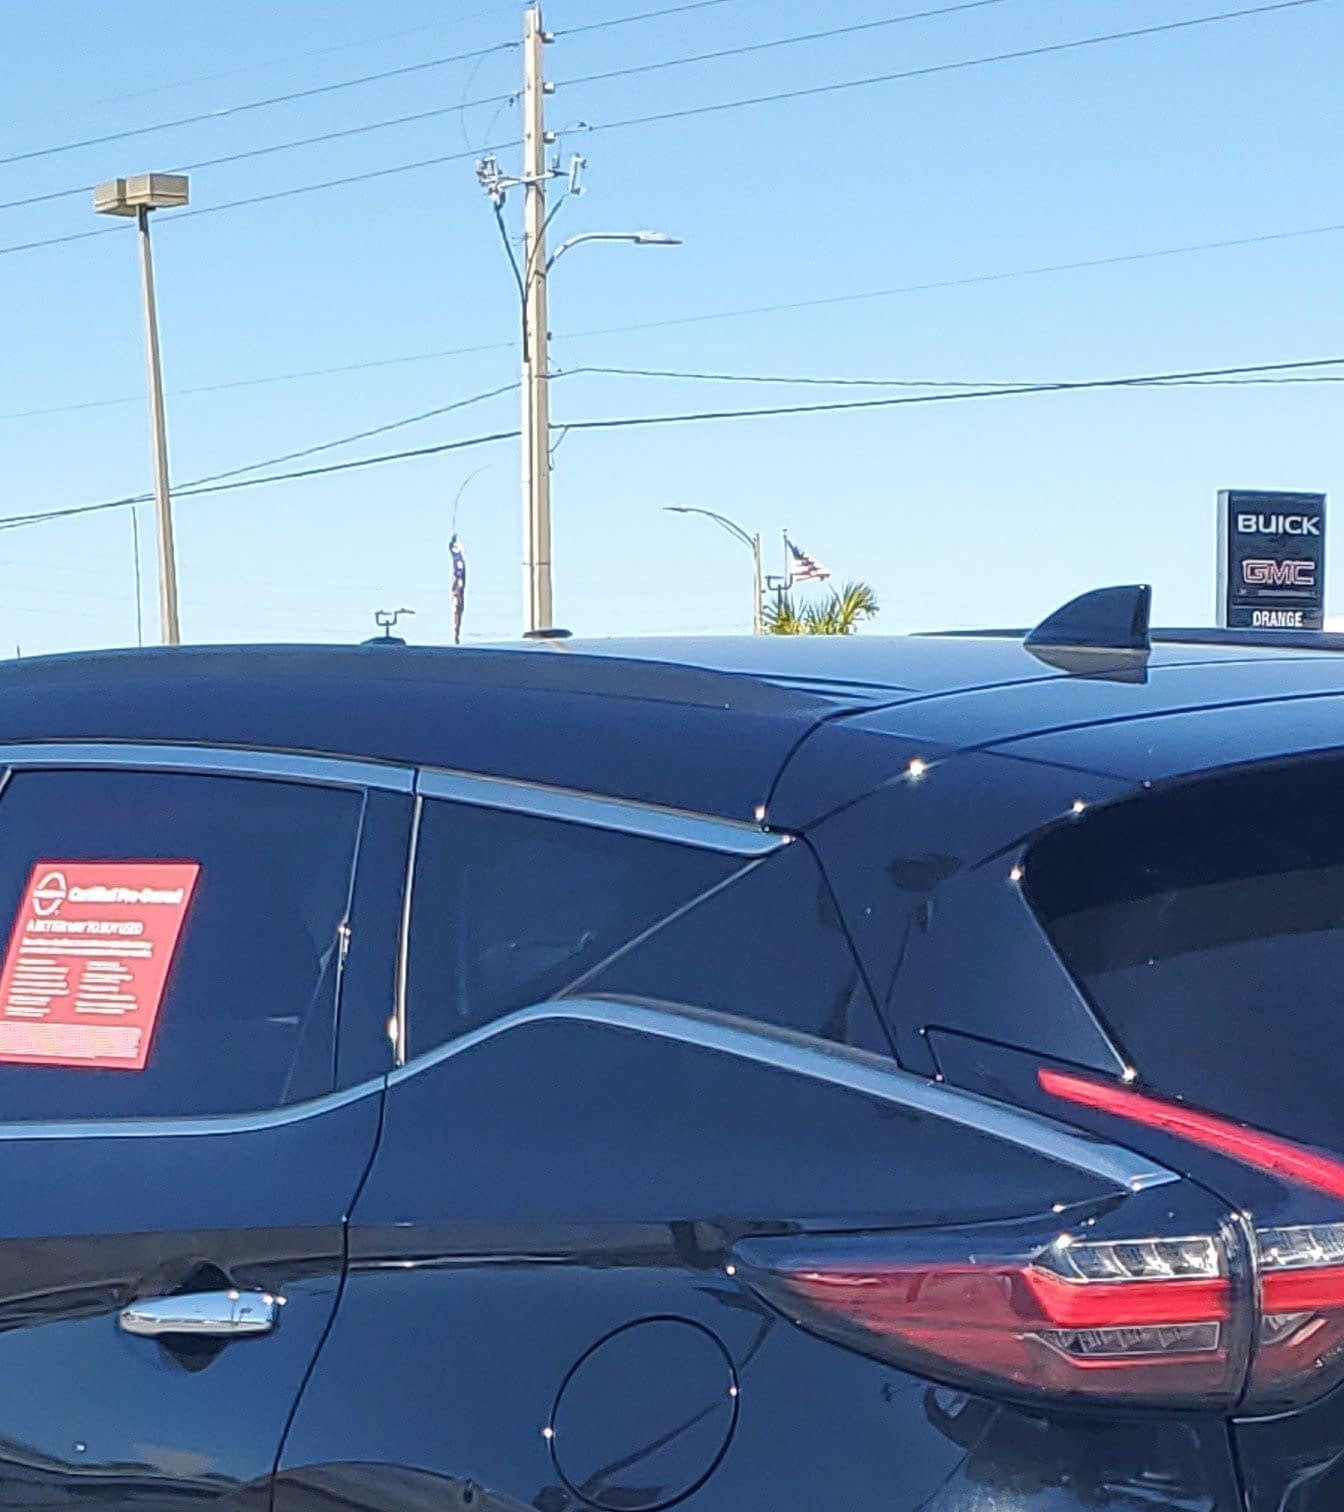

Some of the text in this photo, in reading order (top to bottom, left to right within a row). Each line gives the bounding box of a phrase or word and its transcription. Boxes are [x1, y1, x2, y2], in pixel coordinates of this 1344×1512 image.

[1237, 513, 1320, 535] BUICK
[1242, 559, 1315, 585] GMC
[1252, 611, 1303, 627] ORANGE
